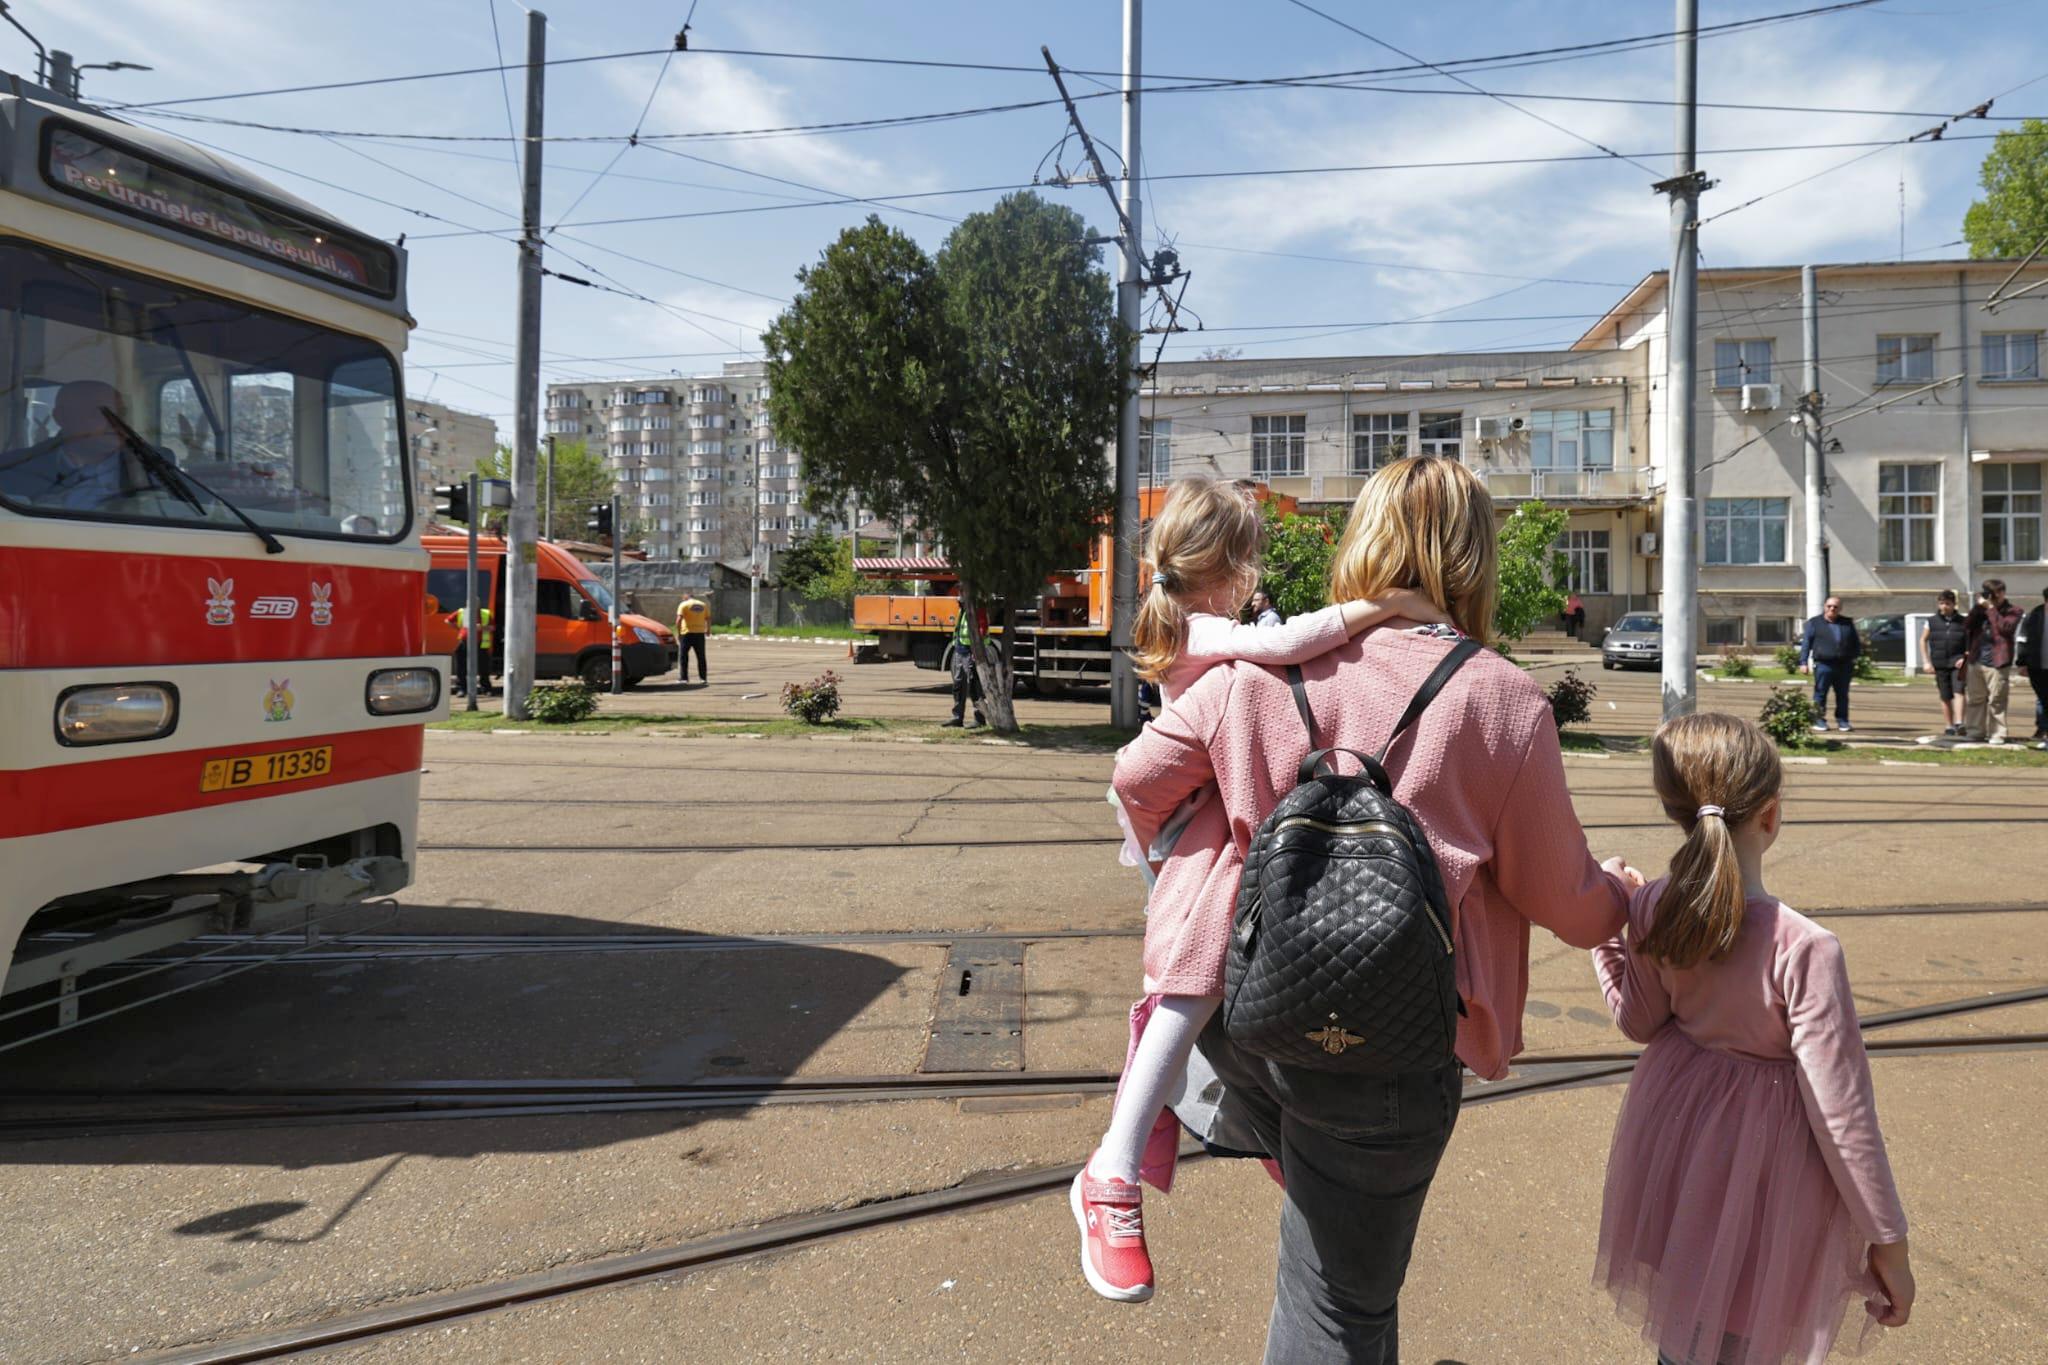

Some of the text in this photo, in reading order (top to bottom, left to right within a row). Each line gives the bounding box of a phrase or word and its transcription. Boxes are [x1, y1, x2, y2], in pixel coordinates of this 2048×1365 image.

[63, 163, 102, 191] Pe
[107, 183, 208, 226] urmele
[250, 600, 294, 615] STB
[231, 749, 327, 785] B 11336
